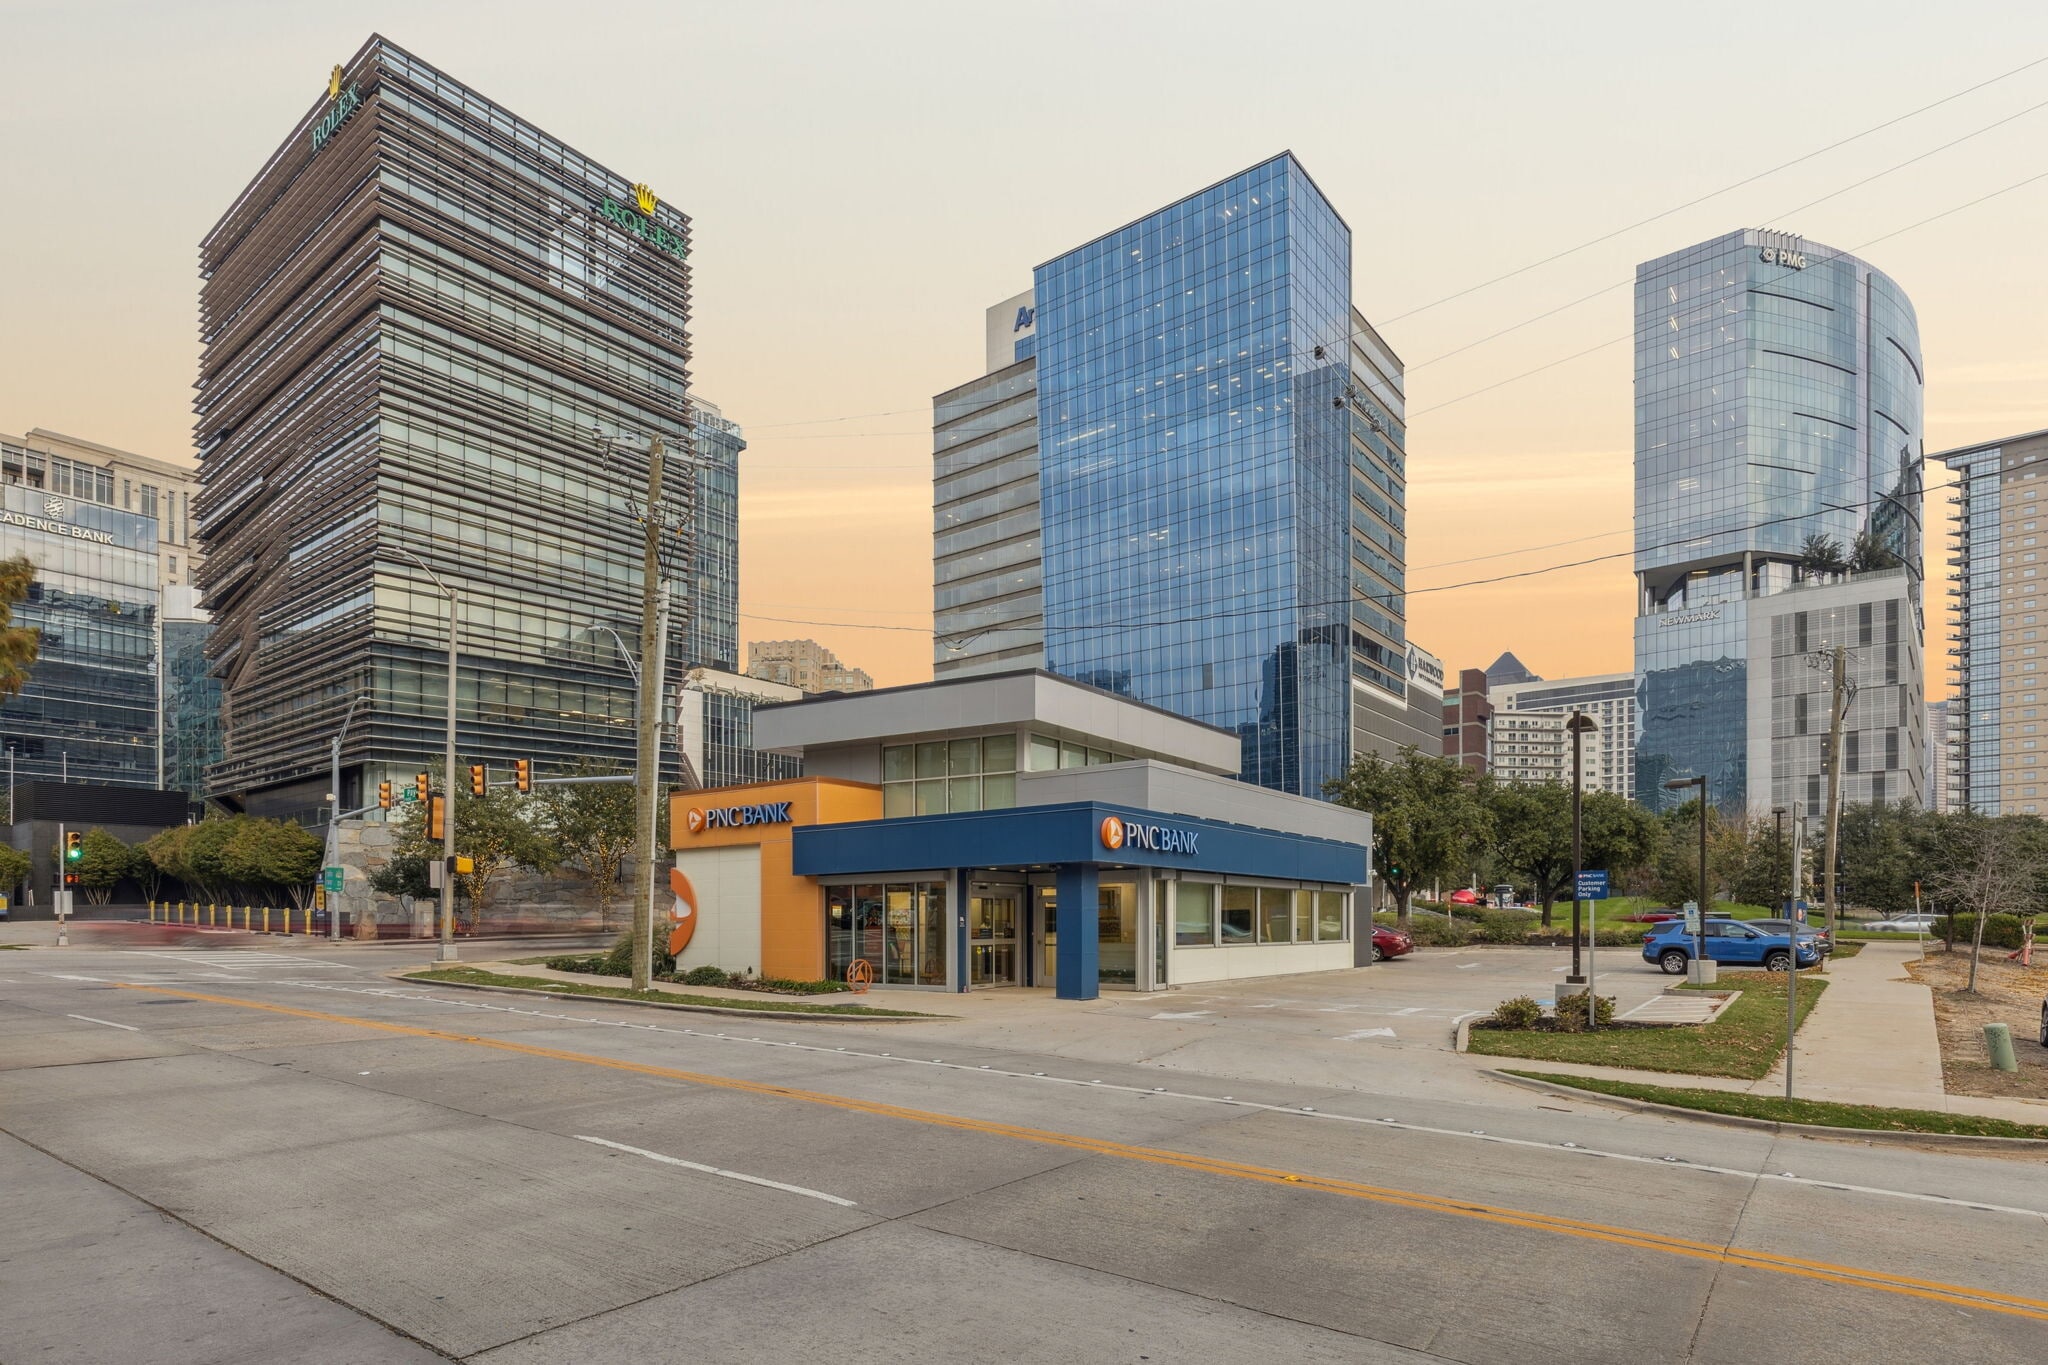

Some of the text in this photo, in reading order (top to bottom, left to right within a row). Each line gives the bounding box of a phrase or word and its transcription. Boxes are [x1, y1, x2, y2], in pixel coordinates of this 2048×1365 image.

[312, 82, 361, 152] ROLEX
[602, 195, 688, 260] ROLEX
[1780, 251, 1806, 269] PMG
[71, 526, 114, 545] BANK
[1658, 610, 1721, 627] NEWMARK
[705, 802, 792, 828] PNC BANK
[1125, 822, 1199, 855] PNC BANK
[1577, 891, 1592, 899] Only
